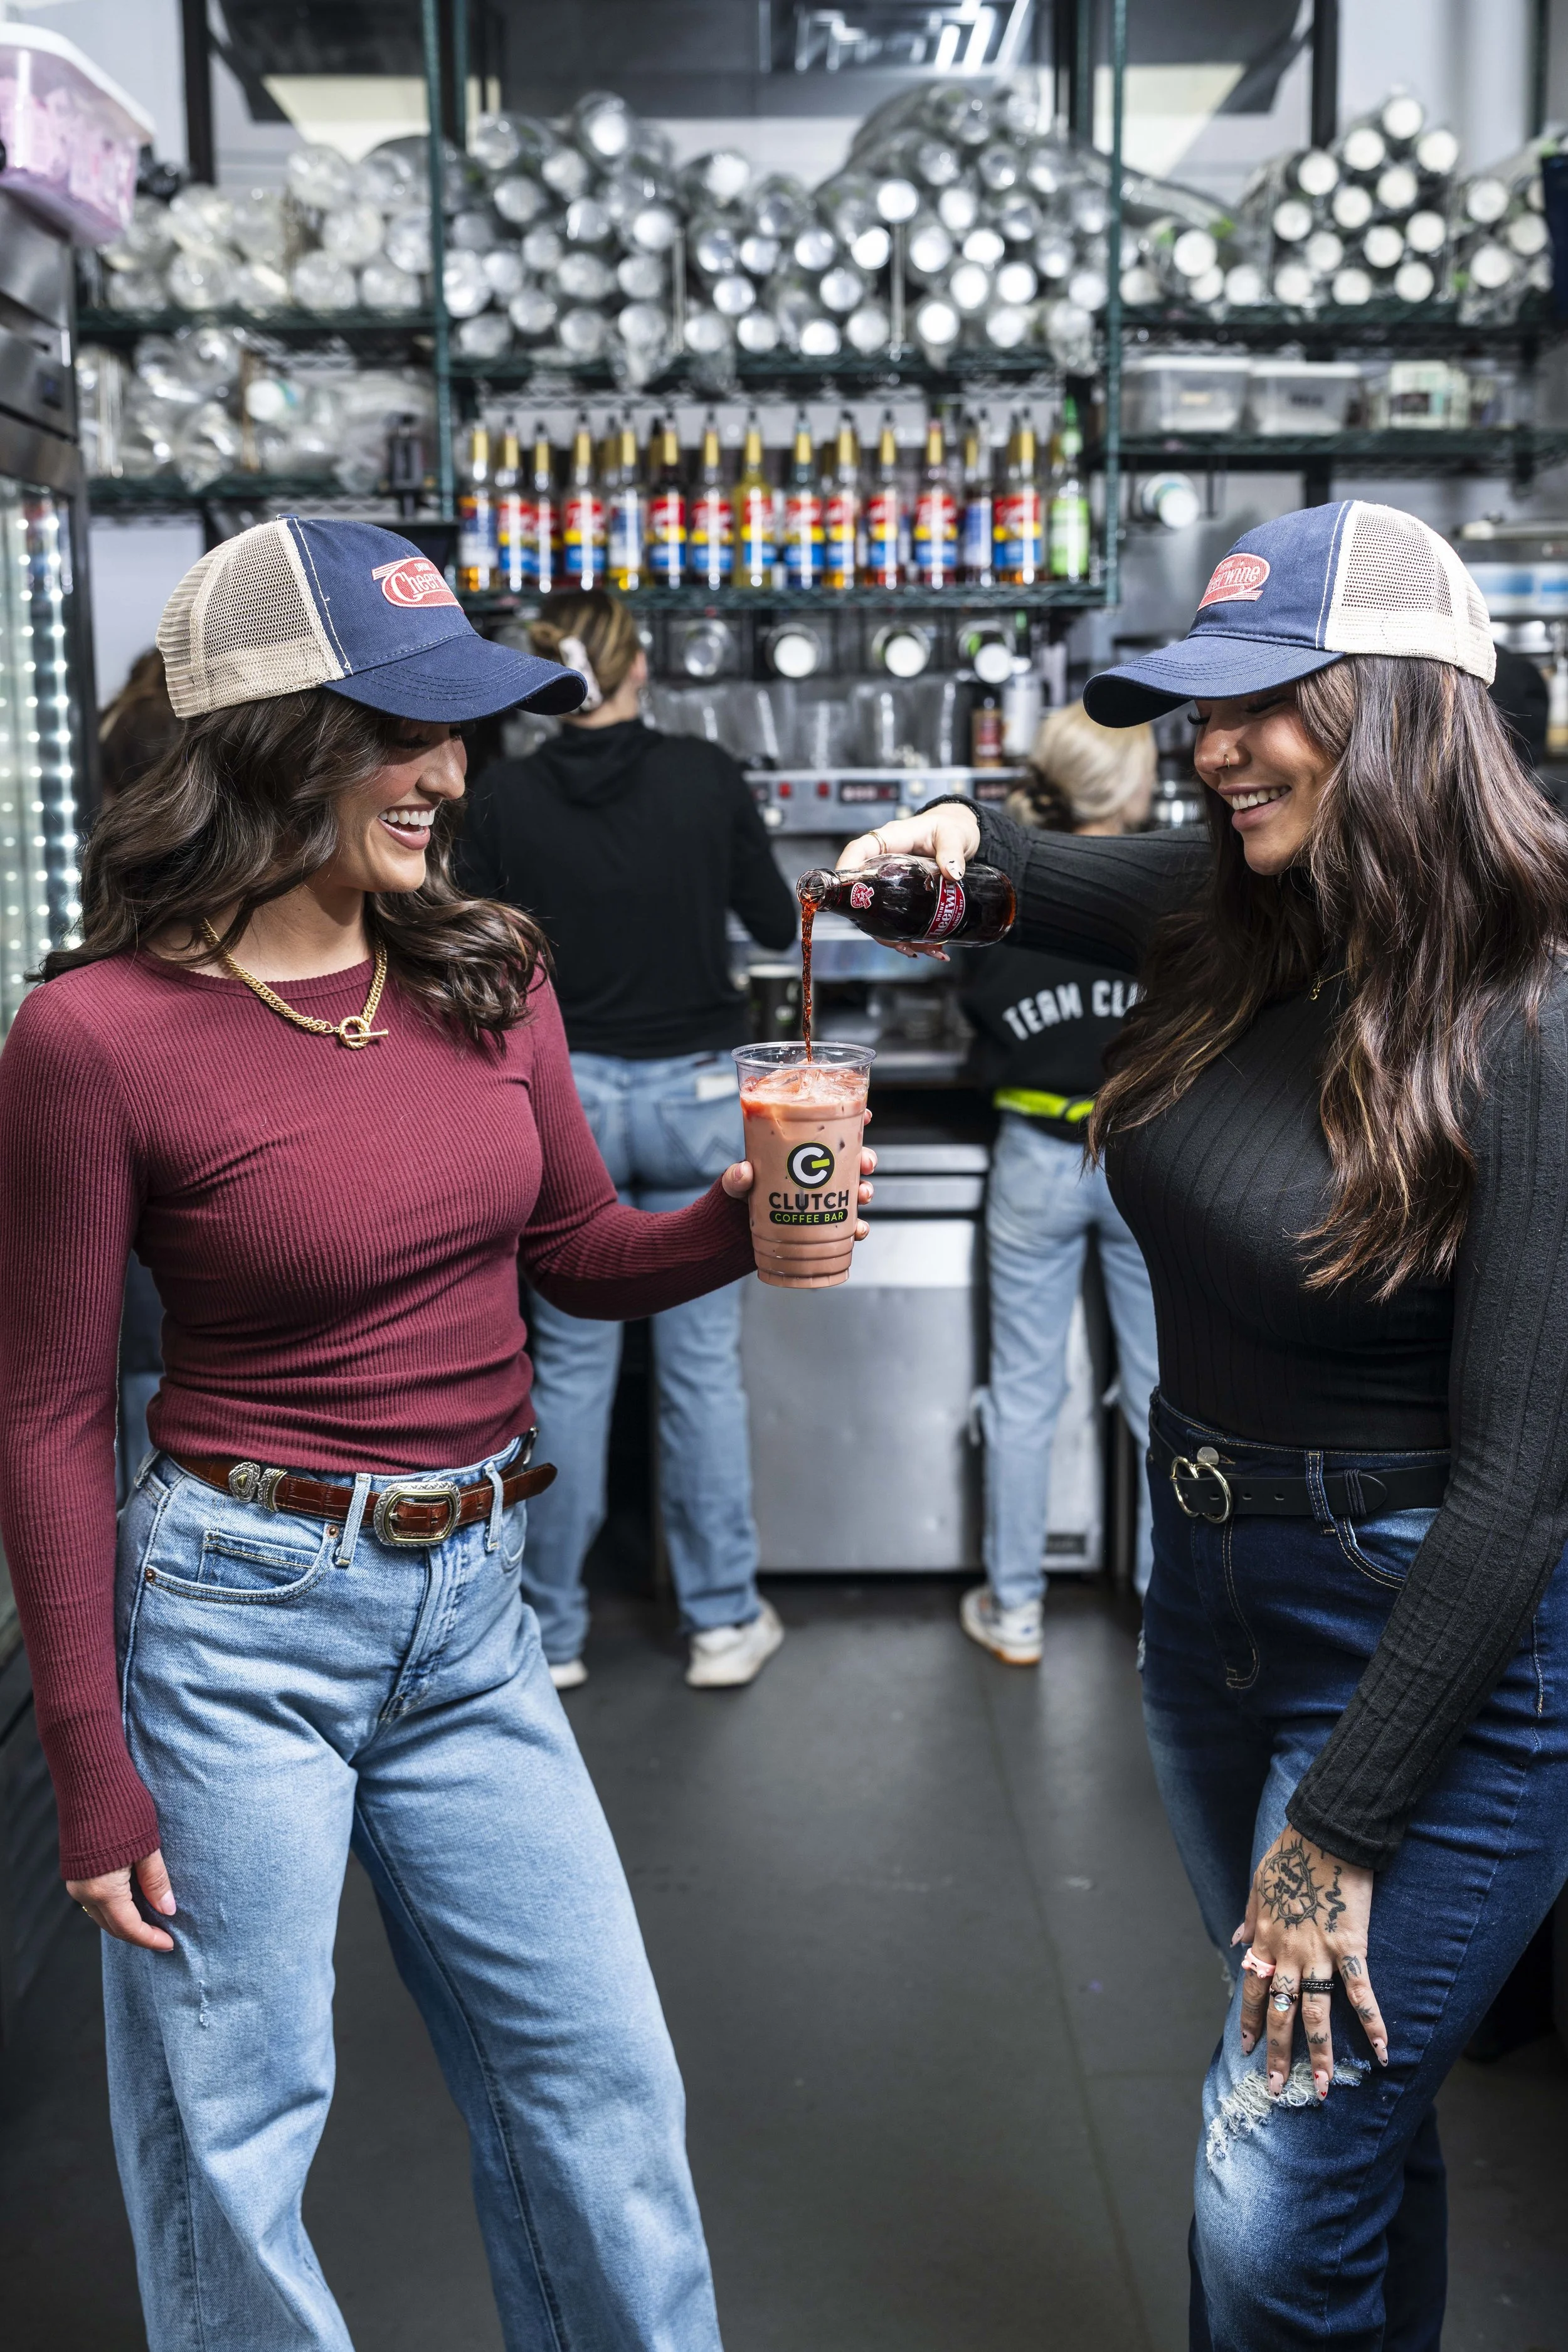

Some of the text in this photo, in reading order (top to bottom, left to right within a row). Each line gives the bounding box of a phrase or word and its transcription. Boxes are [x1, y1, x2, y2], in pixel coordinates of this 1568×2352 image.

[936, 902, 945, 921] DRINK
[952, 912, 962, 927] SINCE
[1002, 982, 1084, 1041] TEAM
[769, 1189, 849, 1210] CLUTCH
[775, 1211, 844, 1223] COFFEE BAR
